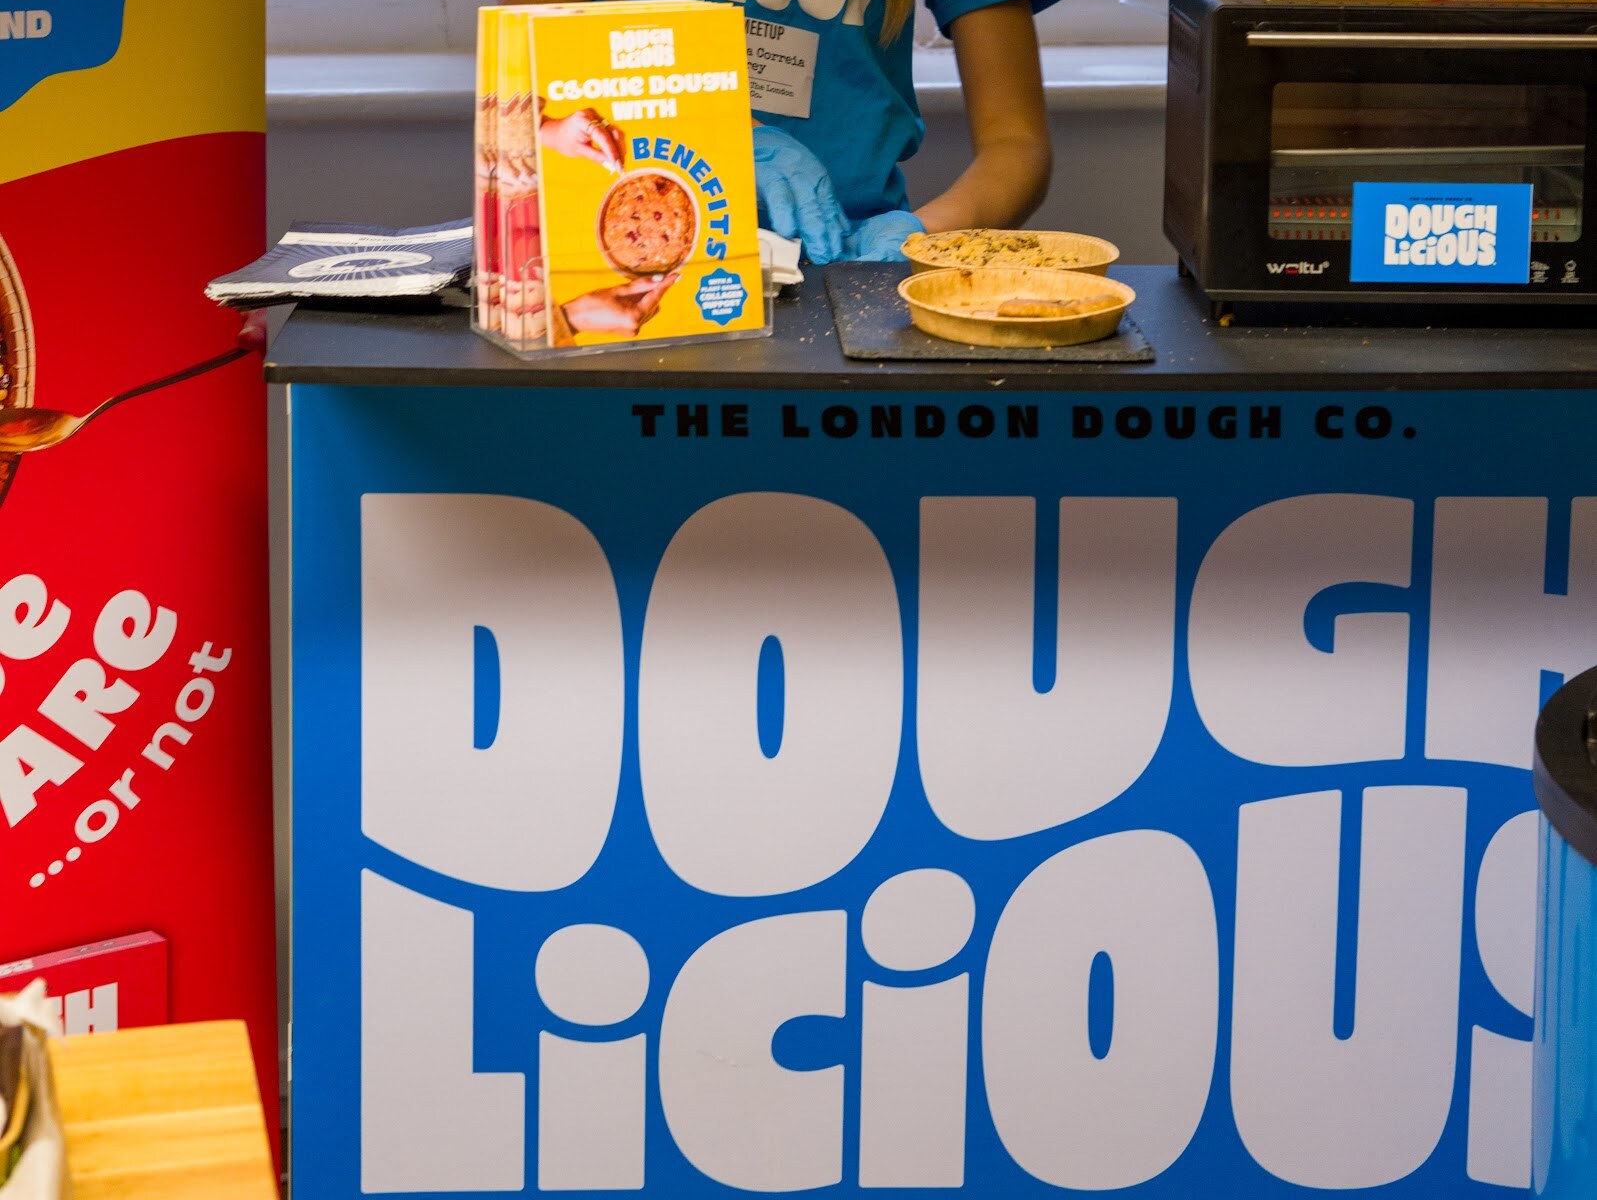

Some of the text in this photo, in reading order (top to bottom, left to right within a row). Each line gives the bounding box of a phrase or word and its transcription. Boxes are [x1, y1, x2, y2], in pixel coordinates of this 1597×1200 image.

[609, 28, 674, 53] DOUGH
[757, 47, 805, 67] Correia
[750, 82, 794, 97] The London
[611, 98, 678, 121] WITH
[632, 137, 730, 260] BENEFITS
[1385, 203, 1498, 240] DOUGH
[632, 404, 1417, 439] THE LONDON DOUGH CO.
[141, 640, 233, 771] not
